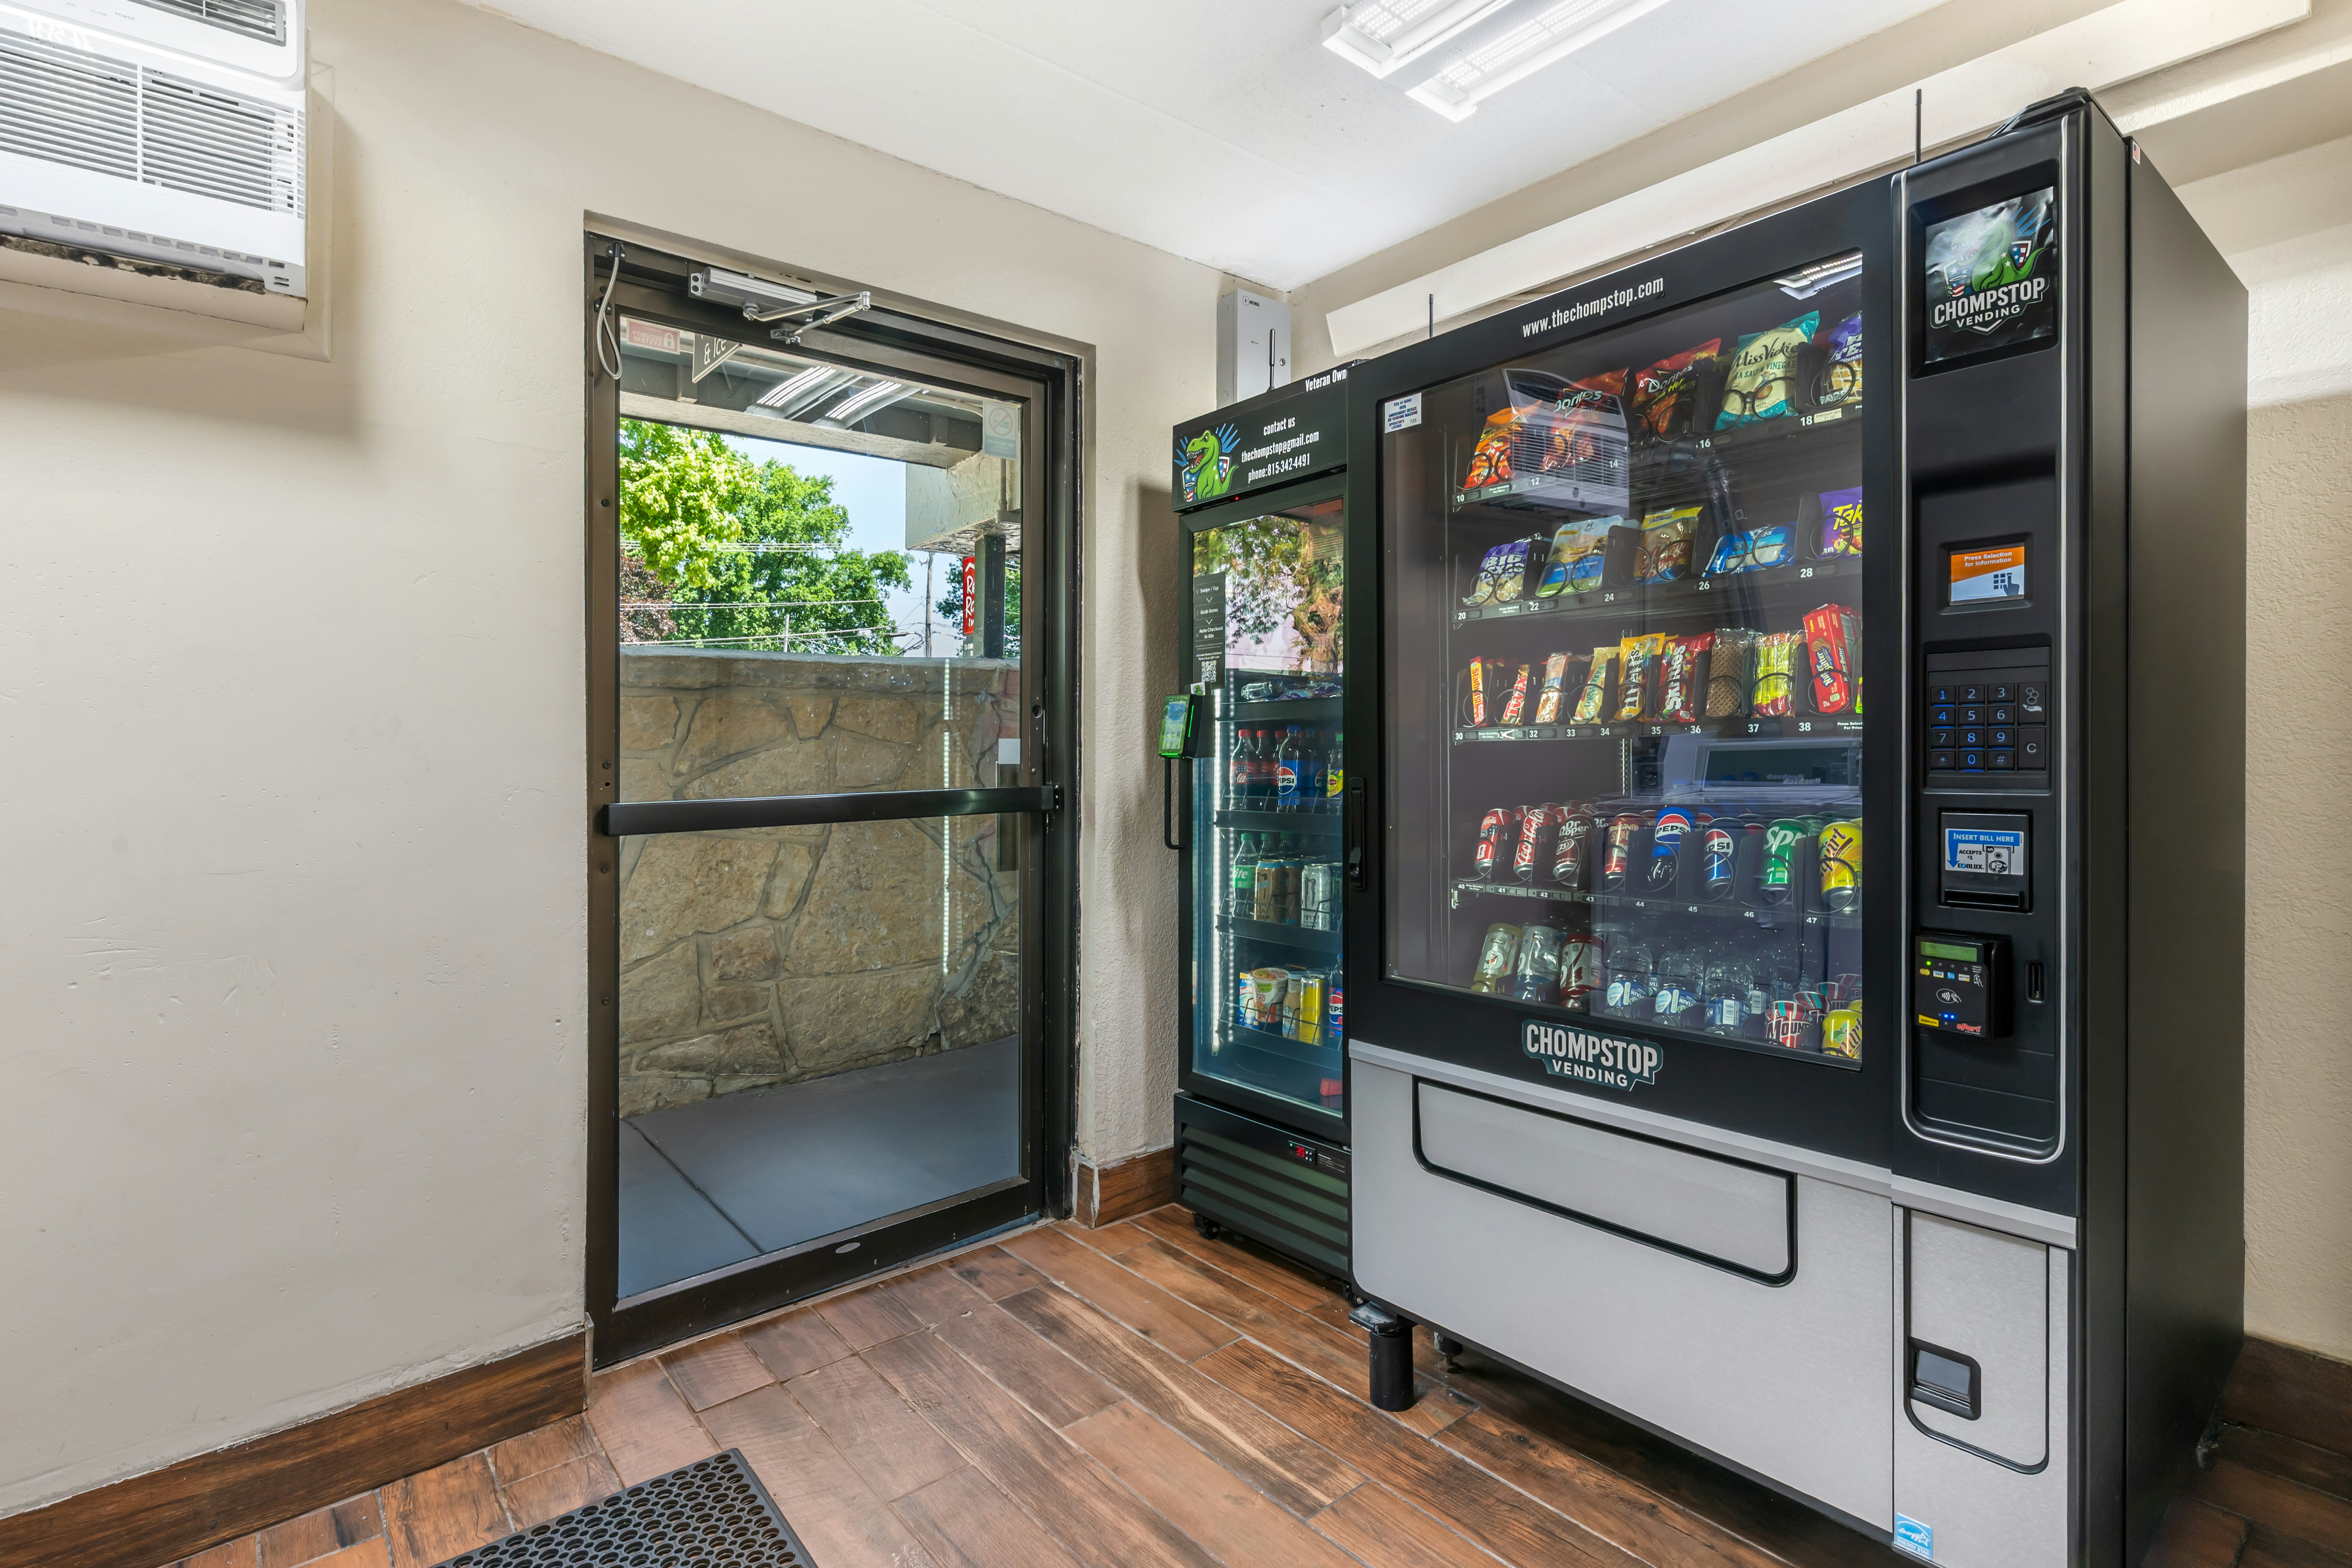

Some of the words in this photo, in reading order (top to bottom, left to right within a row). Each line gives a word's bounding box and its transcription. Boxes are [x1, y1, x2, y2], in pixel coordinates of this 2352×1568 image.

[115, 12, 135, 21] POWER
[1934, 277, 2045, 324] CHOMPSTOP
[1522, 277, 1663, 338] www.thechompstop.com
[1956, 304, 2020, 328] VENDING
[1835, 343, 1862, 360] TE
[1305, 374, 1330, 392] Veteran
[1332, 368, 1348, 383] Own
[1800, 415, 1813, 426] 18
[1264, 419, 1287, 436] contact
[1288, 416, 1295, 428] us
[1241, 430, 1319, 463] thechompstop@gmail.com
[1699, 438, 1711, 448] 16
[1248, 453, 1310, 484] phone:815-342-4491
[1609, 459, 1619, 468] 14
[1531, 477, 1540, 486] 12
[1456, 494, 1465, 503] 10
[1485, 554, 1524, 569] BIG
[1800, 568, 1813, 578] 28
[1699, 581, 1710, 590] 26
[1605, 593, 1614, 602] 24
[1530, 602, 1539, 611] 22
[1458, 612, 1466, 620] 20
[1939, 691, 1945, 700] 1
[1967, 689, 1975, 698] 2
[1997, 688, 2005, 697] 3
[1939, 711, 1947, 721] 4
[1968, 710, 1975, 720] 5
[1997, 710, 2005, 719] 6
[1600, 728, 1610, 736] 34
[1651, 726, 1661, 735] 35
[1690, 725, 1701, 734] 36
[1748, 724, 1759, 733] 37
[1799, 723, 1811, 732] 38
[1939, 733, 1946, 742] 7
[1967, 733, 1976, 742] 8
[1997, 732, 2005, 742] 9
[2026, 743, 2037, 753] C
[1968, 754, 1976, 764] 0
[1566, 821, 1580, 830] Dr
[1956, 1023, 1981, 1032] ePort
[1526, 1024, 1658, 1078] CHOMPSTOP
[1552, 1059, 1628, 1087] VENDING
[1897, 1538, 1916, 1550] ENERGY
[1917, 1547, 1930, 1556] STAR
